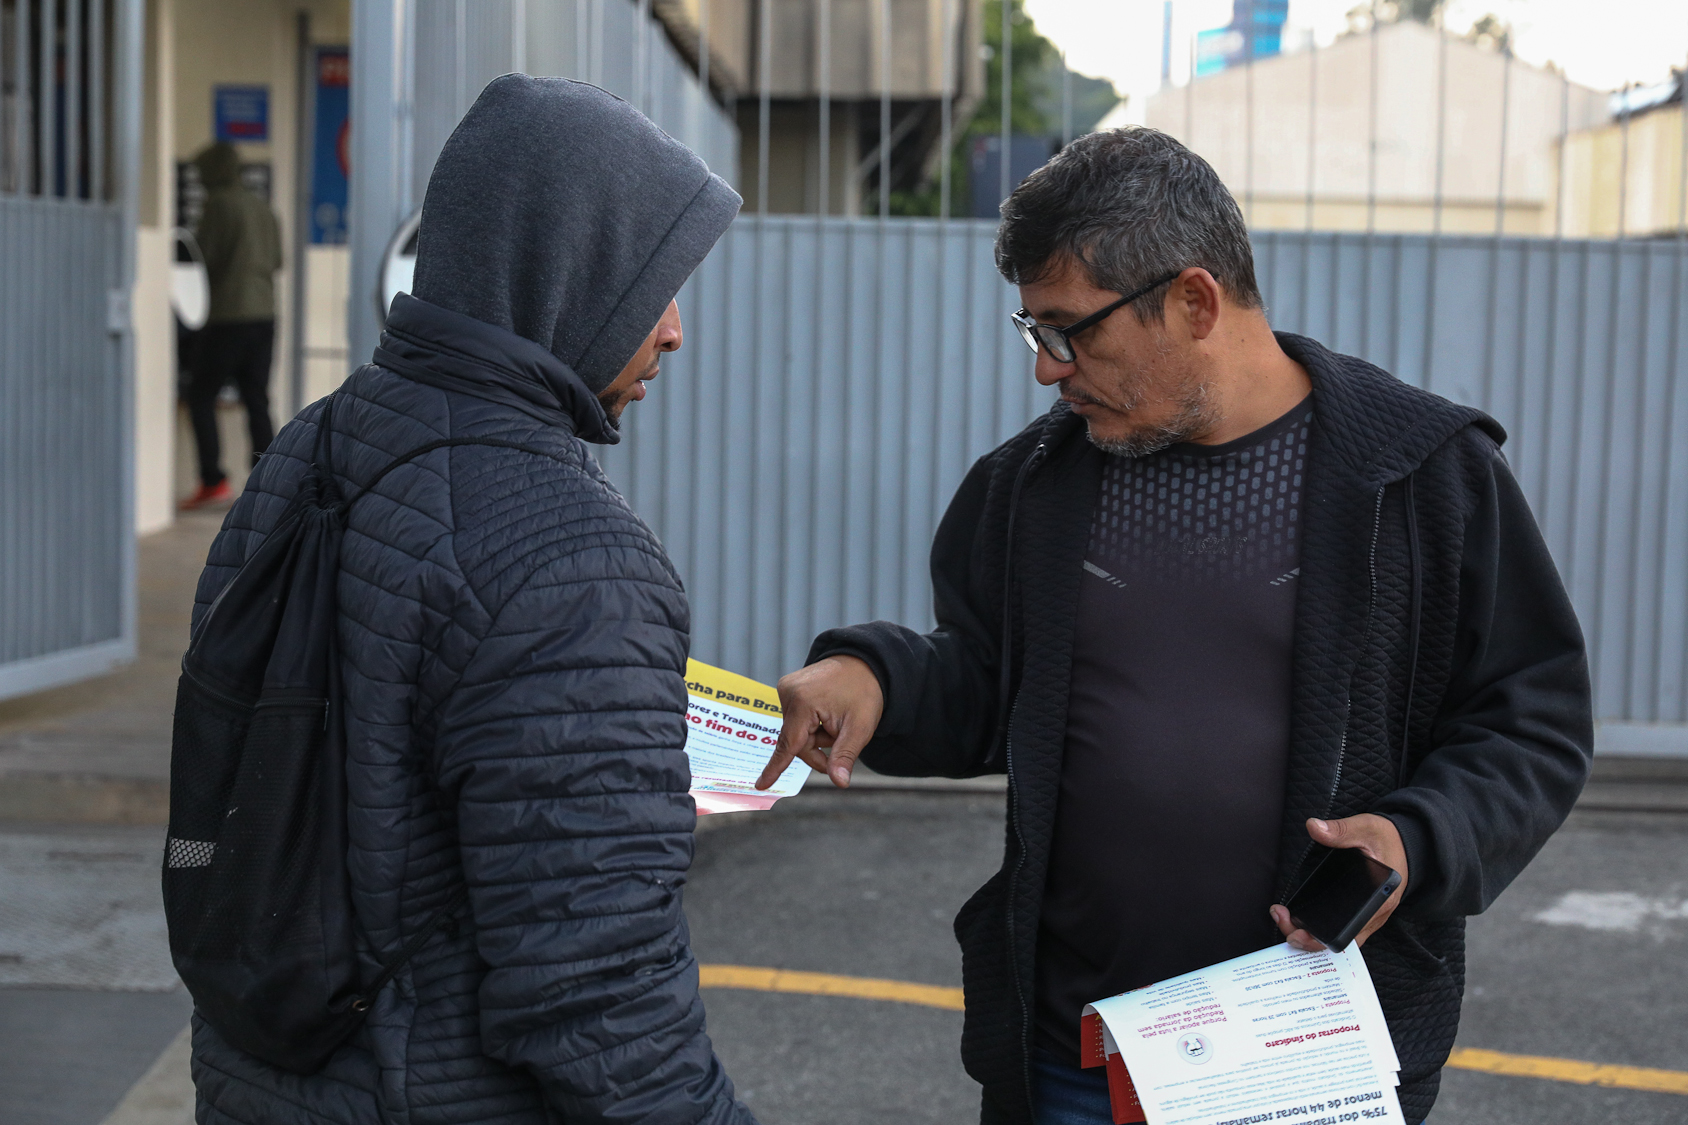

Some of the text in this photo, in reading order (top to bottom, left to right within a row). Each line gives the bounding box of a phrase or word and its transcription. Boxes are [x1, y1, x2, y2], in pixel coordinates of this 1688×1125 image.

[715, 690, 750, 705] para
[753, 699, 783, 714] Bras
[688, 703, 711, 714] ores
[722, 713, 782, 735] Trabalhado
[705, 719, 733, 734] fim
[736, 730, 757, 740] do
[761, 736, 777, 746] 6x
[1311, 966, 1336, 977] Proposta
[1192, 1003, 1221, 1014] redução
[1325, 999, 1350, 1008] Proposta
[1193, 1009, 1224, 1021] Redução
[1202, 1015, 1227, 1026] Porque
[1154, 1019, 1181, 1030] Jornada
[1179, 1021, 1200, 1031] apoiar
[1142, 1031, 1157, 1039] pela
[1158, 1028, 1172, 1036] luta
[1265, 1023, 1360, 1049] Propostas do Sindicato
[1344, 1091, 1382, 1104] menos
[1309, 1102, 1325, 1113] 44
[1327, 1099, 1342, 1110] de
[1276, 1106, 1307, 1120] horas
[1338, 1112, 1359, 1124] dos
[1361, 1106, 1387, 1120] 75%
